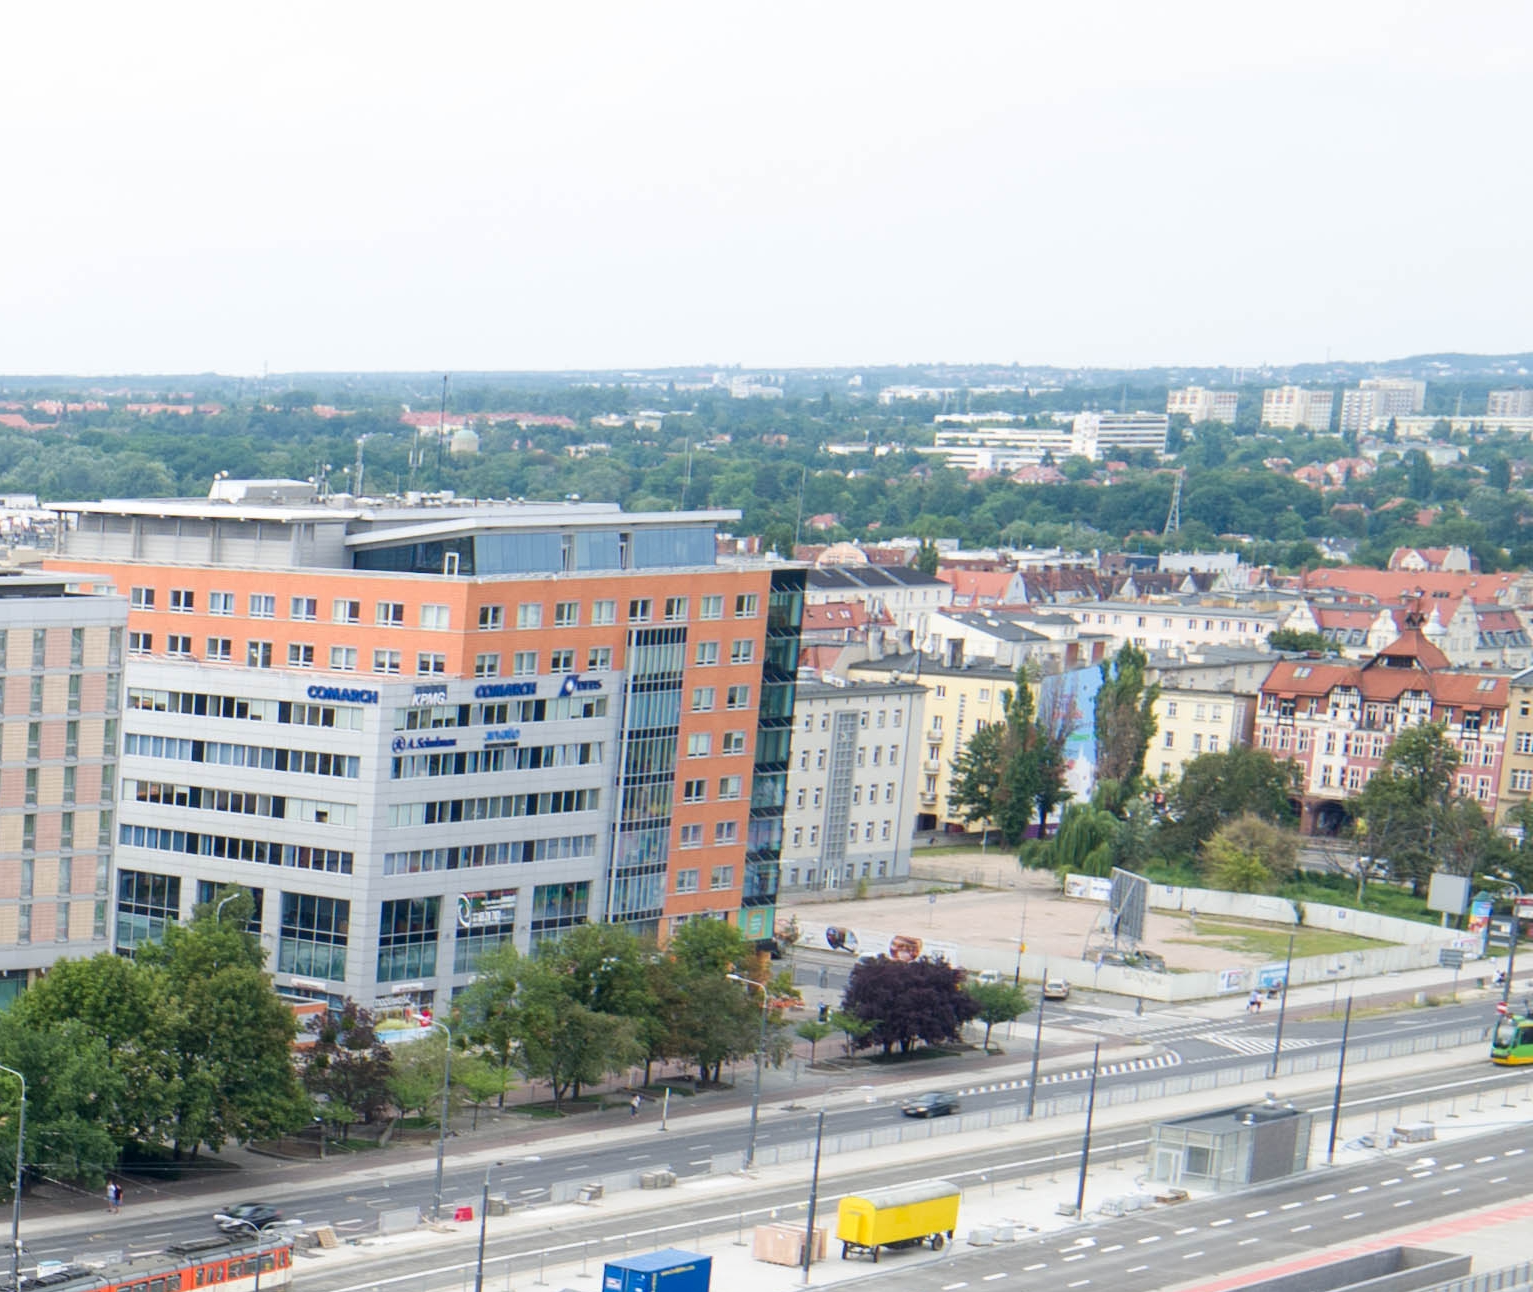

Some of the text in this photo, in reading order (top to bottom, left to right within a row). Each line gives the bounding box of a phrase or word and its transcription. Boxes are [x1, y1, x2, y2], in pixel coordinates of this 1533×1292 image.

[307, 684, 379, 704] COMARCH
[411, 690, 447, 707] KPMG
[475, 682, 538, 699] COMARCH
